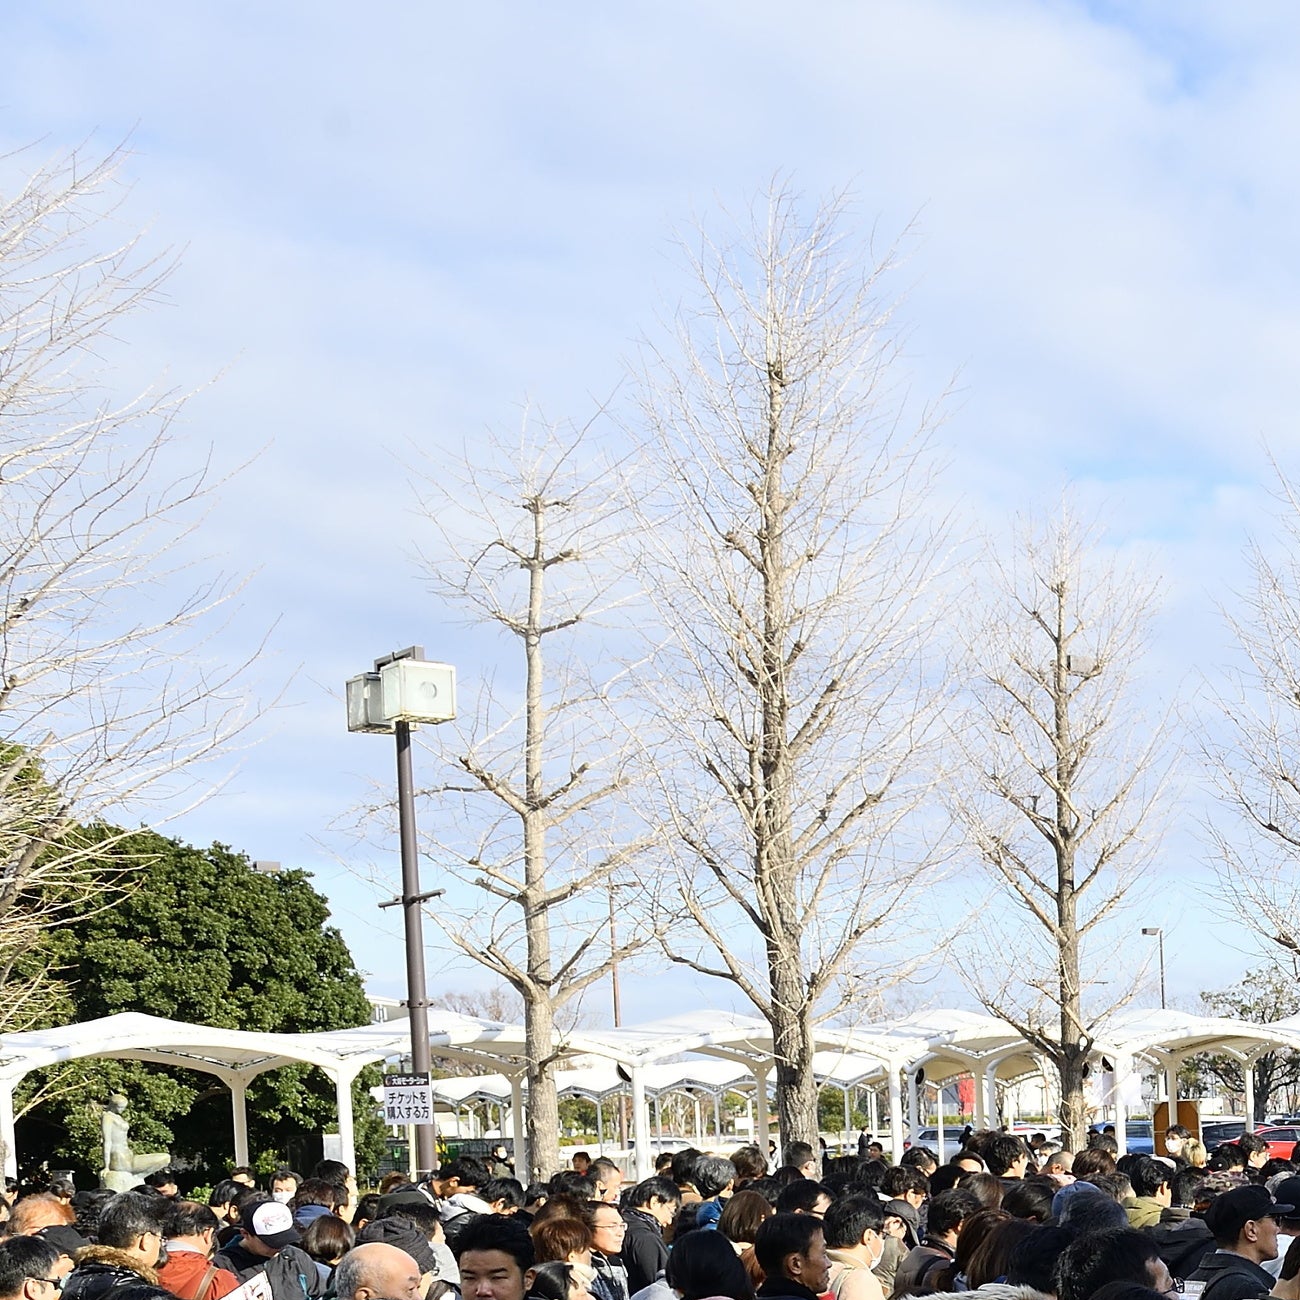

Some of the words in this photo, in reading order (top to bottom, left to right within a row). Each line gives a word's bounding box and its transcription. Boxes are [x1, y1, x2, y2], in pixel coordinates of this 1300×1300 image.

[388, 1091, 426, 1105] チケットを
[387, 1106, 429, 1120] 購入する方
